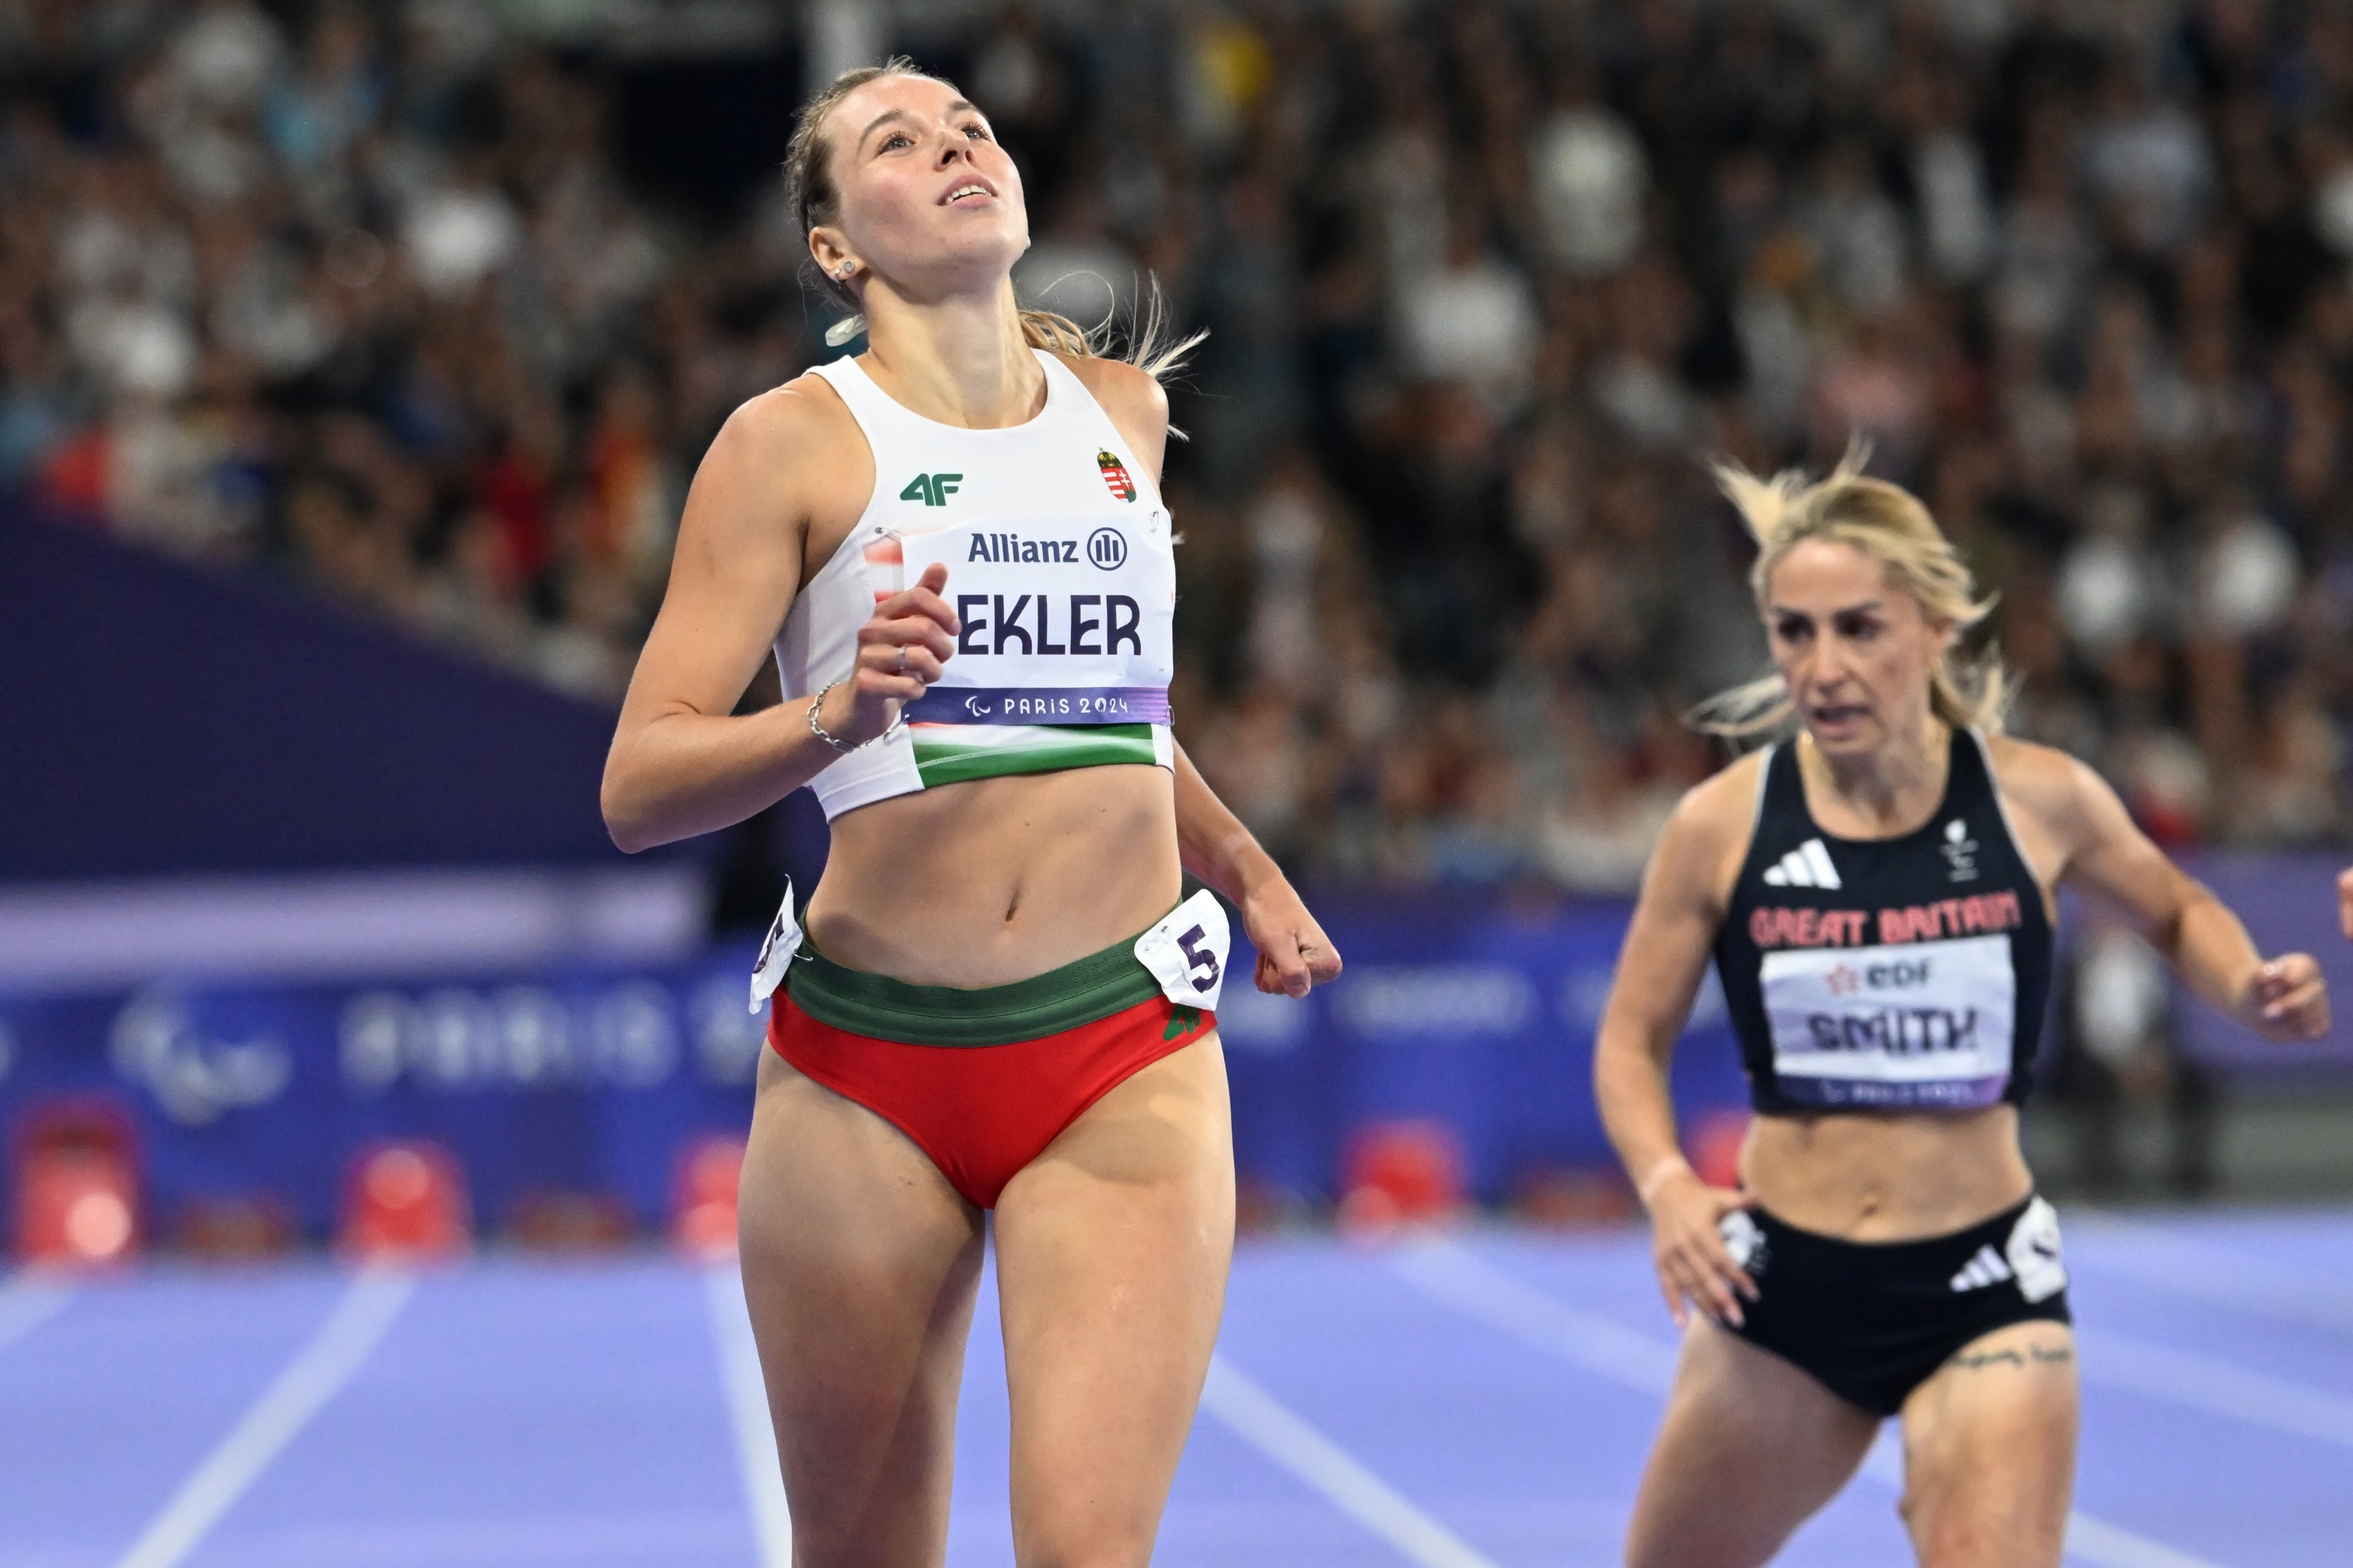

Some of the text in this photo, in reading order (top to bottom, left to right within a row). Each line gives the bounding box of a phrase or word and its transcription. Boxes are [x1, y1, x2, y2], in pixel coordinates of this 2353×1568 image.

[899, 473, 963, 506] 4F
[968, 533, 1079, 563] Allianz
[957, 595, 1142, 656] EKLER
[1004, 698, 1129, 715] PARIS 2024
[1749, 890, 2021, 948] GREAT BRITAIN
[1176, 923, 1221, 993] 5
[1806, 1007, 1978, 1057] SMITH
